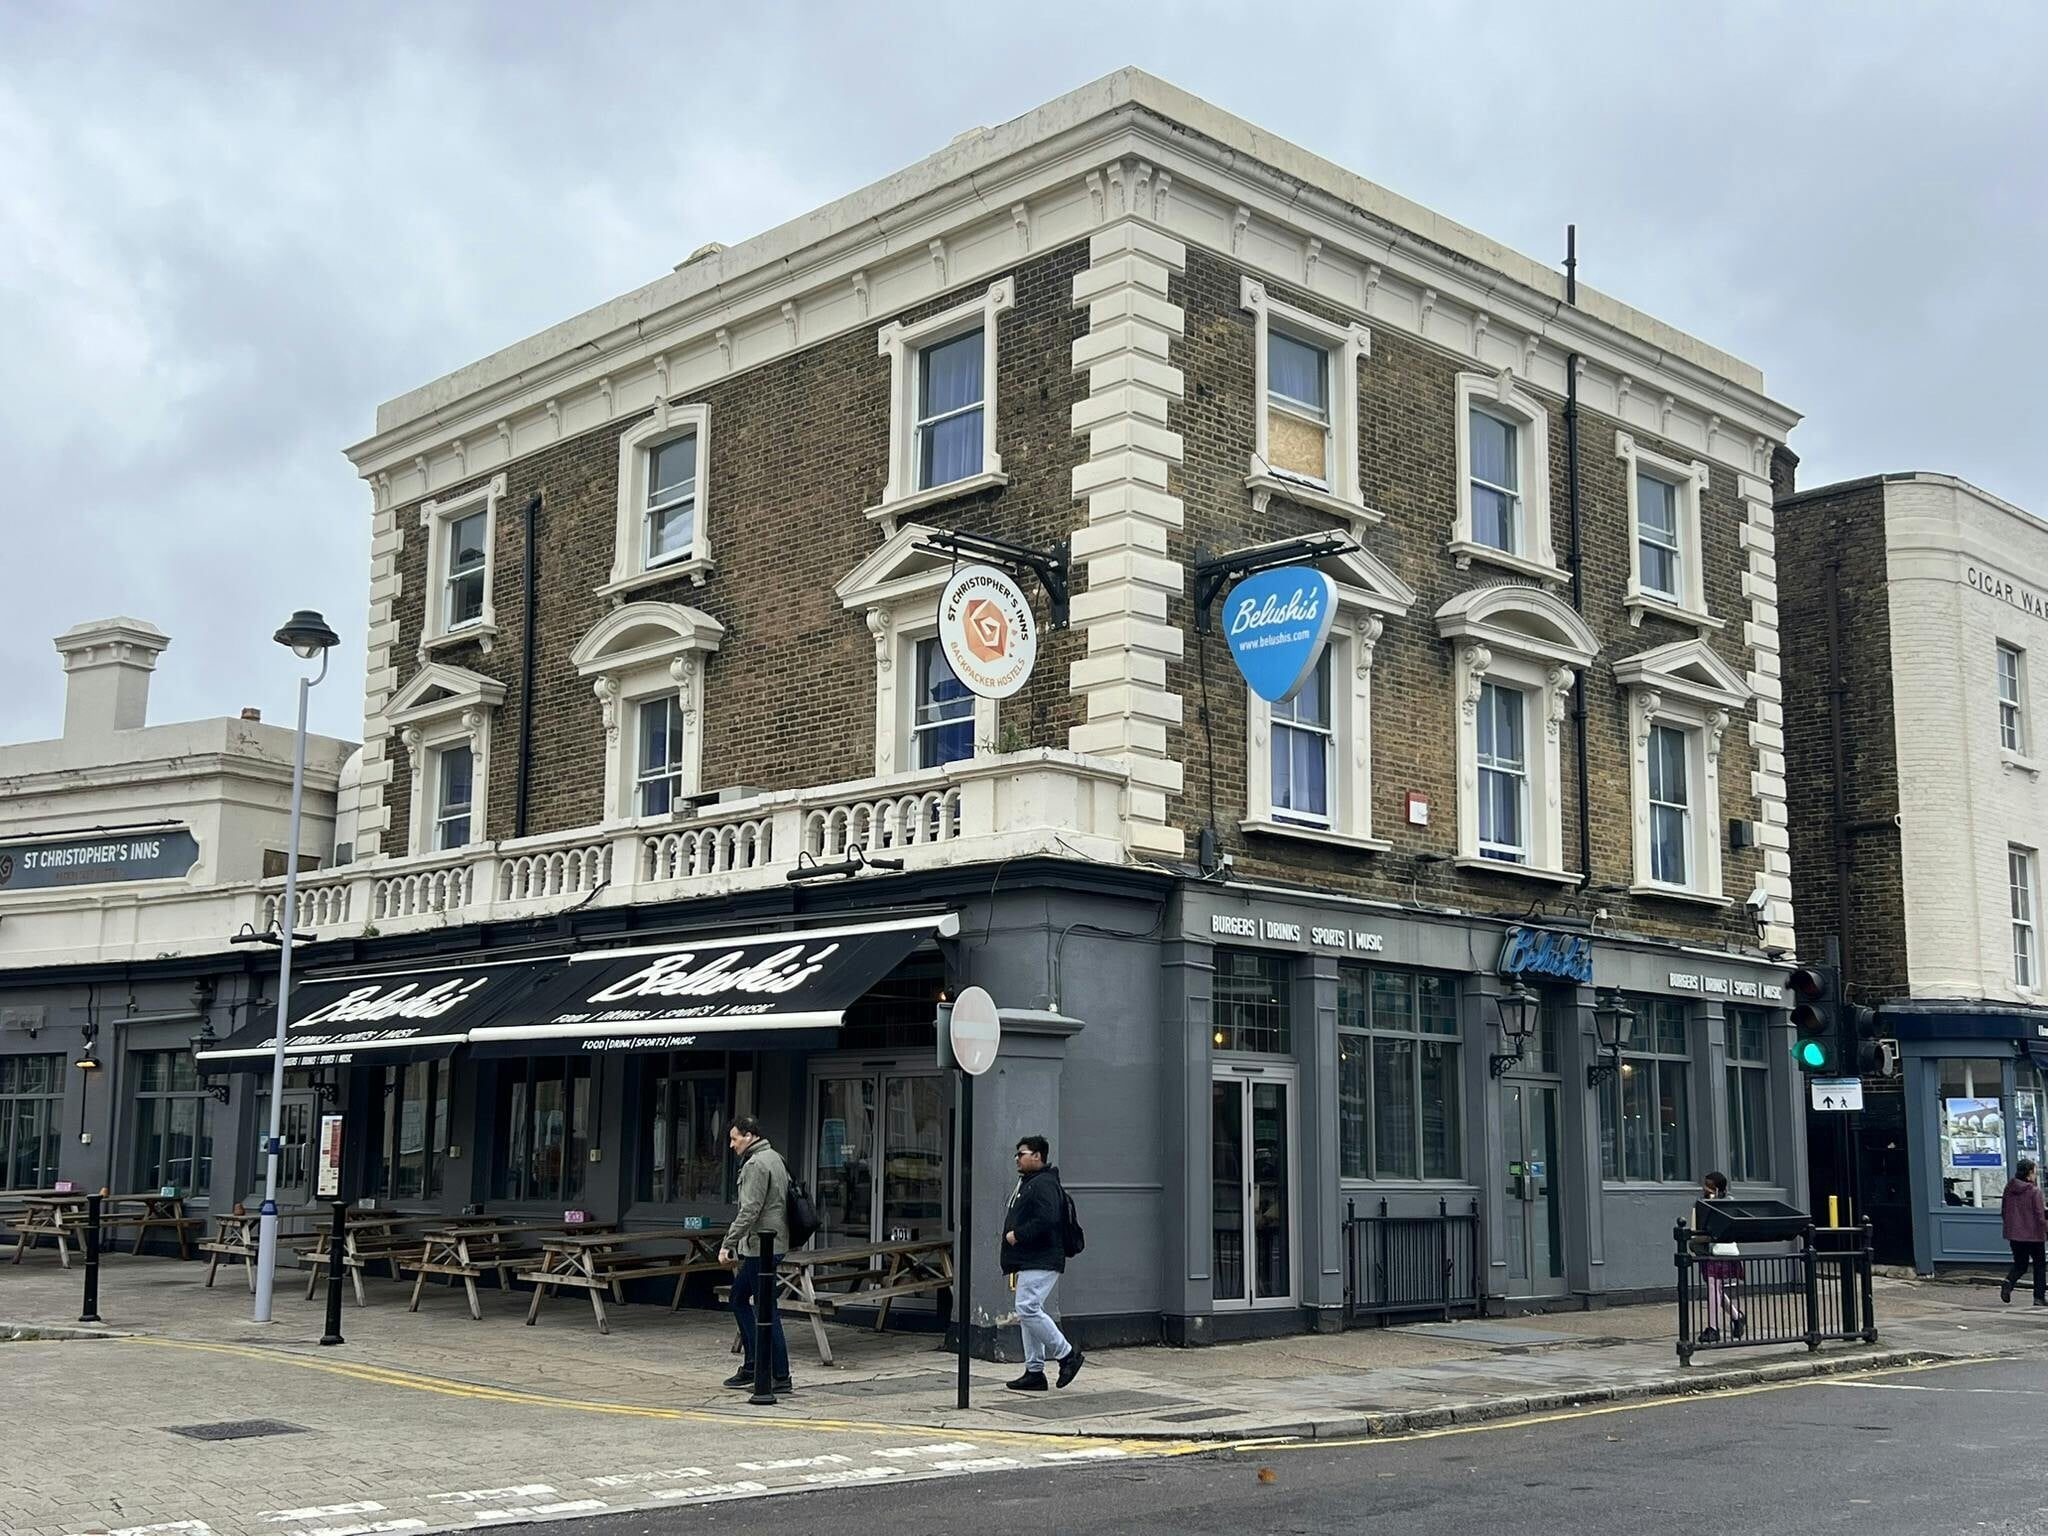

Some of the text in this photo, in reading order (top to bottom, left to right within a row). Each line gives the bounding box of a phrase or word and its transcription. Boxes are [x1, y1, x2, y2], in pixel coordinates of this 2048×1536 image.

[947, 576, 1029, 641] ST CHRISTOPHER'S INNS
[1231, 586, 1319, 636] Belushi's
[1240, 630, 1310, 651] www.belushis.com
[950, 641, 1026, 687] BACKPACKER HOSTELS
[24, 841, 160, 869] ST CHRISTOPHER'S INNS
[1212, 914, 1383, 952] BURGERS DRINKS SPORTS MUSIC
[586, 943, 840, 1003] Belushi's
[1669, 973, 1782, 1000] BURGERS DRINKS SPORTS MUSIC
[289, 977, 489, 1029] Belushi's
[550, 1003, 776, 1024] FOOD DRINKS SPORTS MUSIC
[582, 1036, 697, 1050] FOOD DRINK SPORTS MUSIC
